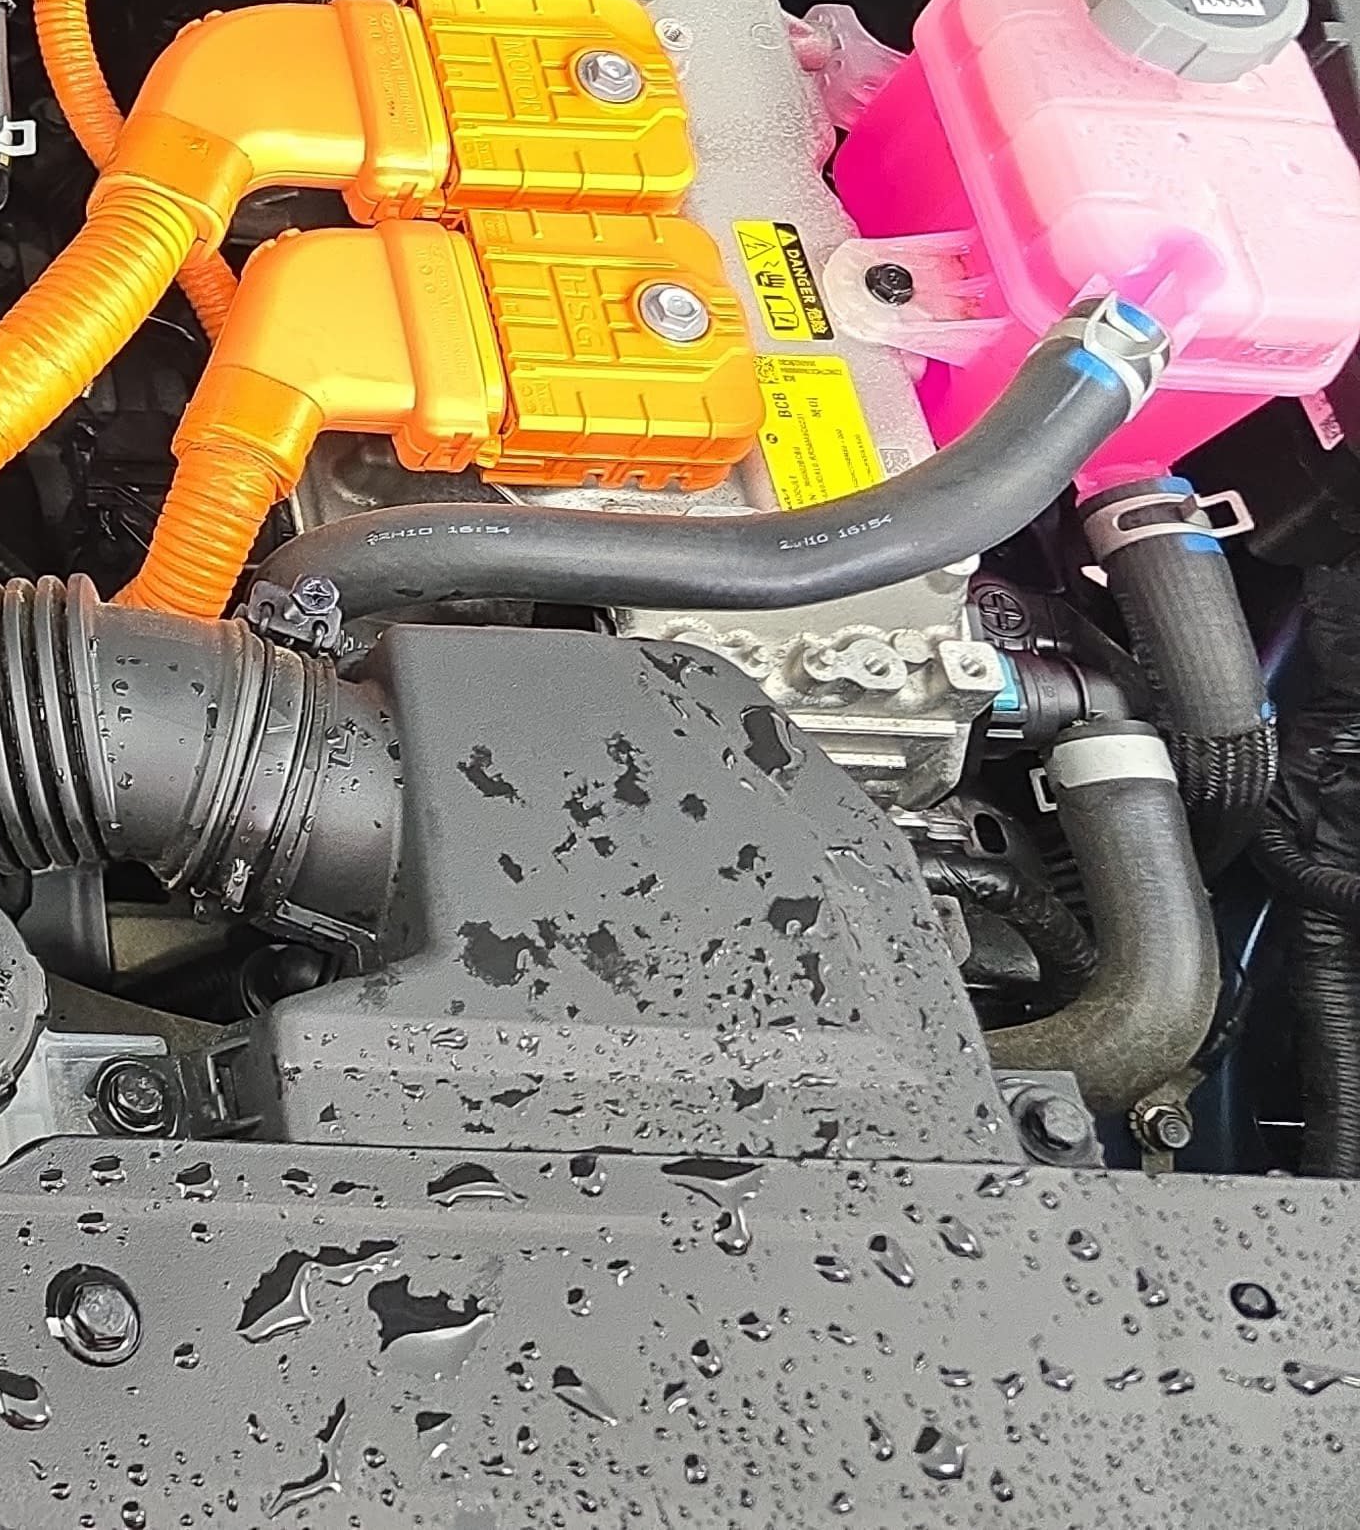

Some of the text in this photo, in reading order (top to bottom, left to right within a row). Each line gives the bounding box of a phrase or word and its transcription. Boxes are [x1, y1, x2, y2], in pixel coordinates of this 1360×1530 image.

[502, 39, 545, 111] MOTOR
[559, 272, 605, 348] HSG
[784, 248, 817, 306] DANGER
